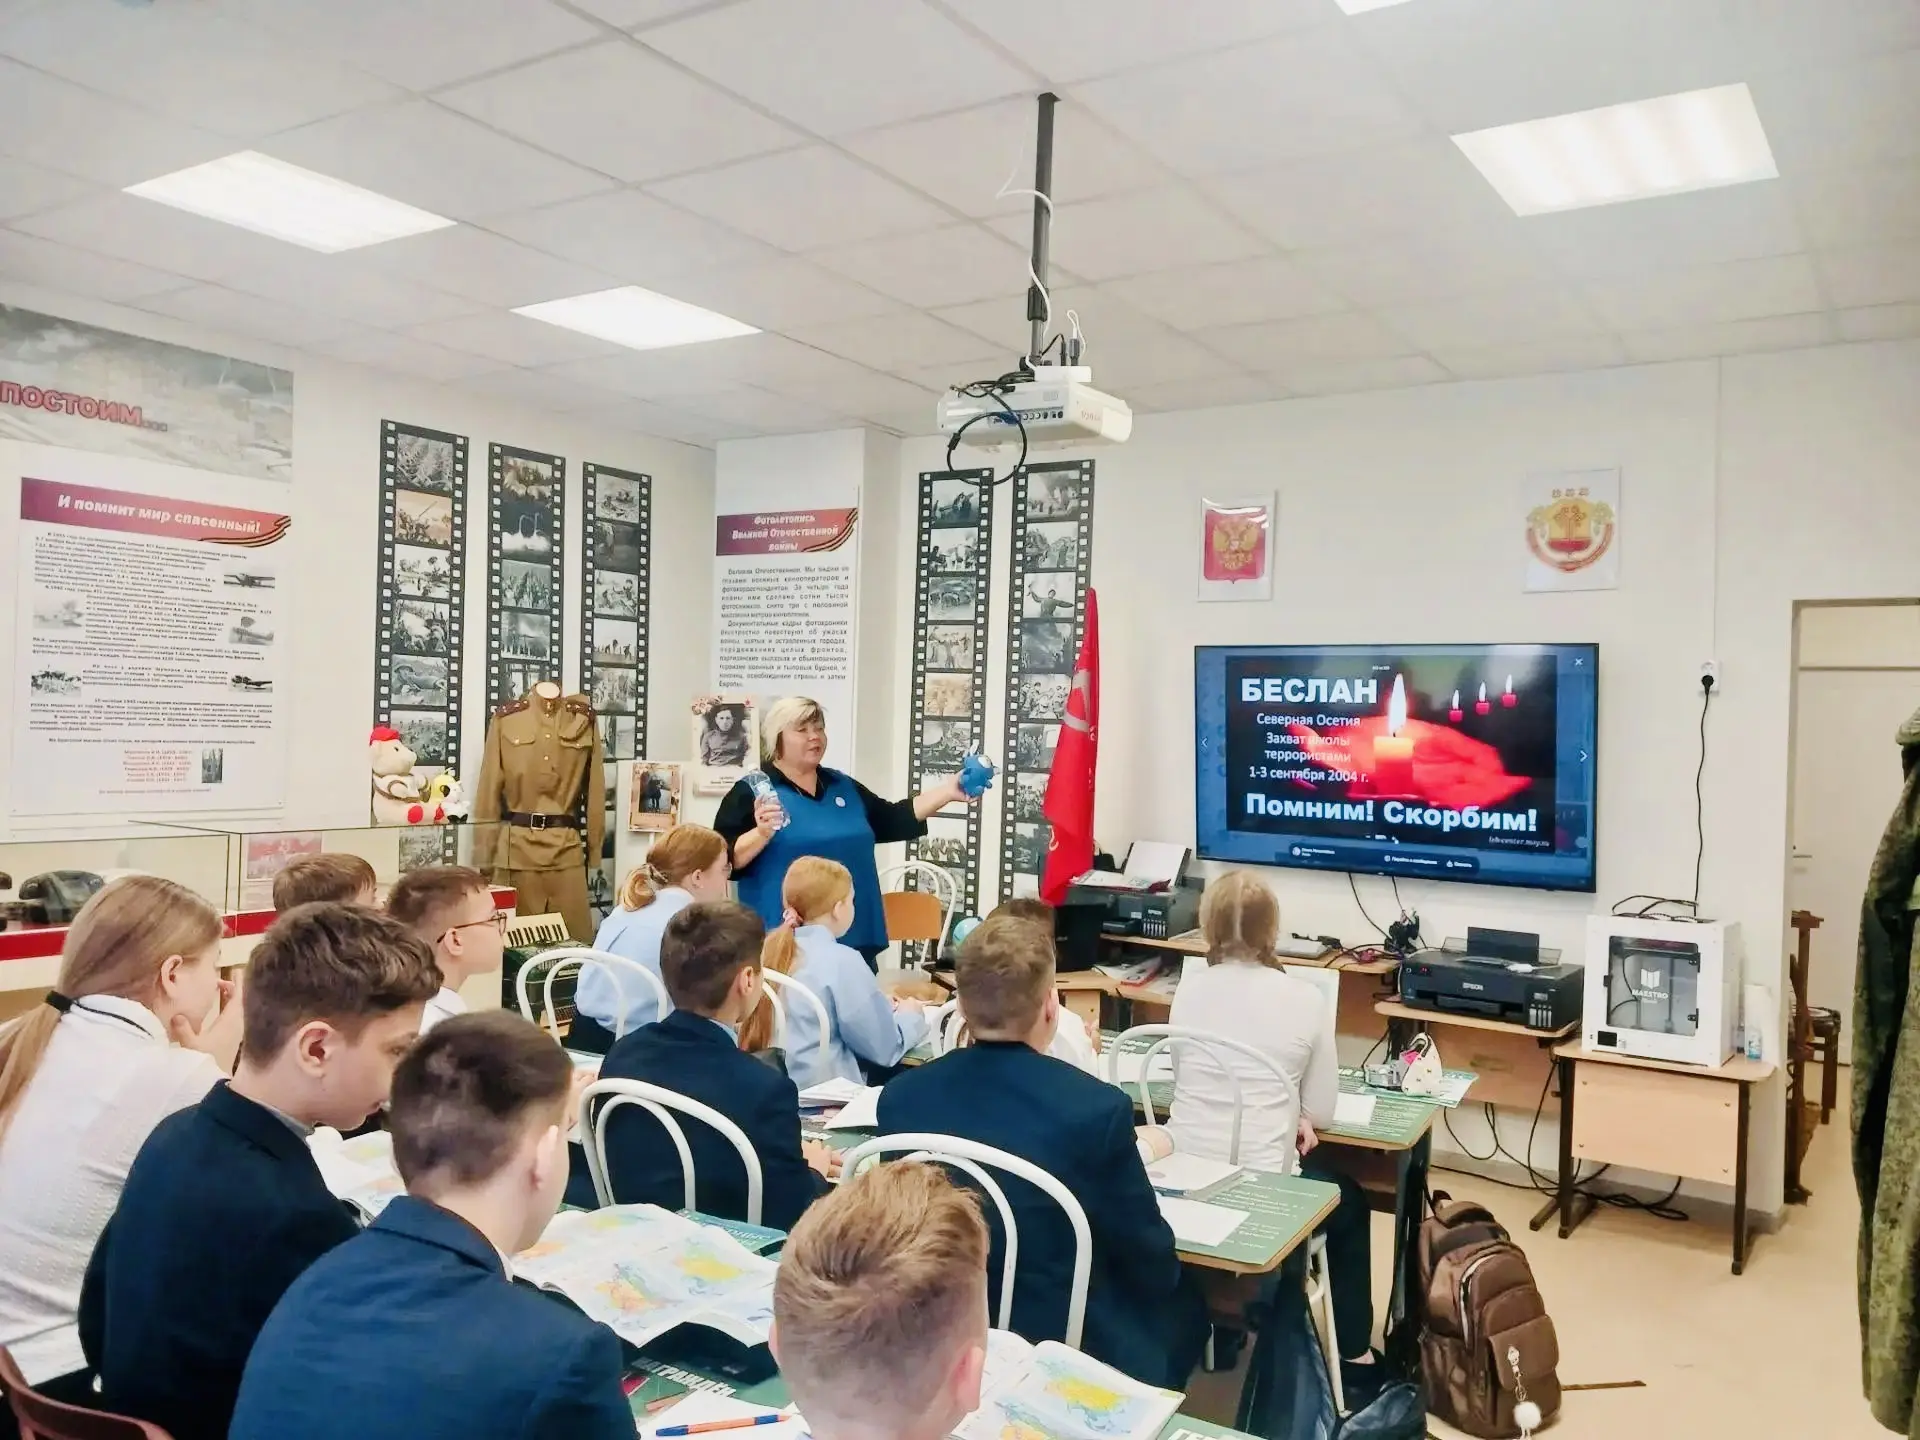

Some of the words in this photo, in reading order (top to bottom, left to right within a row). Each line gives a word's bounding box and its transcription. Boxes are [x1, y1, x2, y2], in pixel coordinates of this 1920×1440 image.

[58, 494, 70, 508] И
[74, 498, 136, 517] помнит
[138, 507, 171, 524] мир
[174, 512, 261, 534] спасенный!
[754, 514, 816, 525] Фотолетопись
[732, 528, 769, 541] Великой
[770, 524, 839, 538] Отечественной
[768, 541, 799, 552] войны
[1241, 678, 1378, 704] БЕСЛАН
[1256, 713, 1313, 727] Северная
[1316, 714, 1361, 727] Осетия
[1266, 732, 1305, 745] Захват
[1308, 736, 1350, 746] школы
[1264, 749, 1351, 764] террористами
[1249, 766, 1267, 778] 1-3
[1270, 768, 1325, 782] сентября
[1328, 770, 1358, 782] 2004
[1361, 773, 1369, 783] г.
[1246, 793, 1375, 822] Помним!
[1383, 801, 1538, 833] Скорбим!
[1631, 989, 1669, 999] MAESTRO
